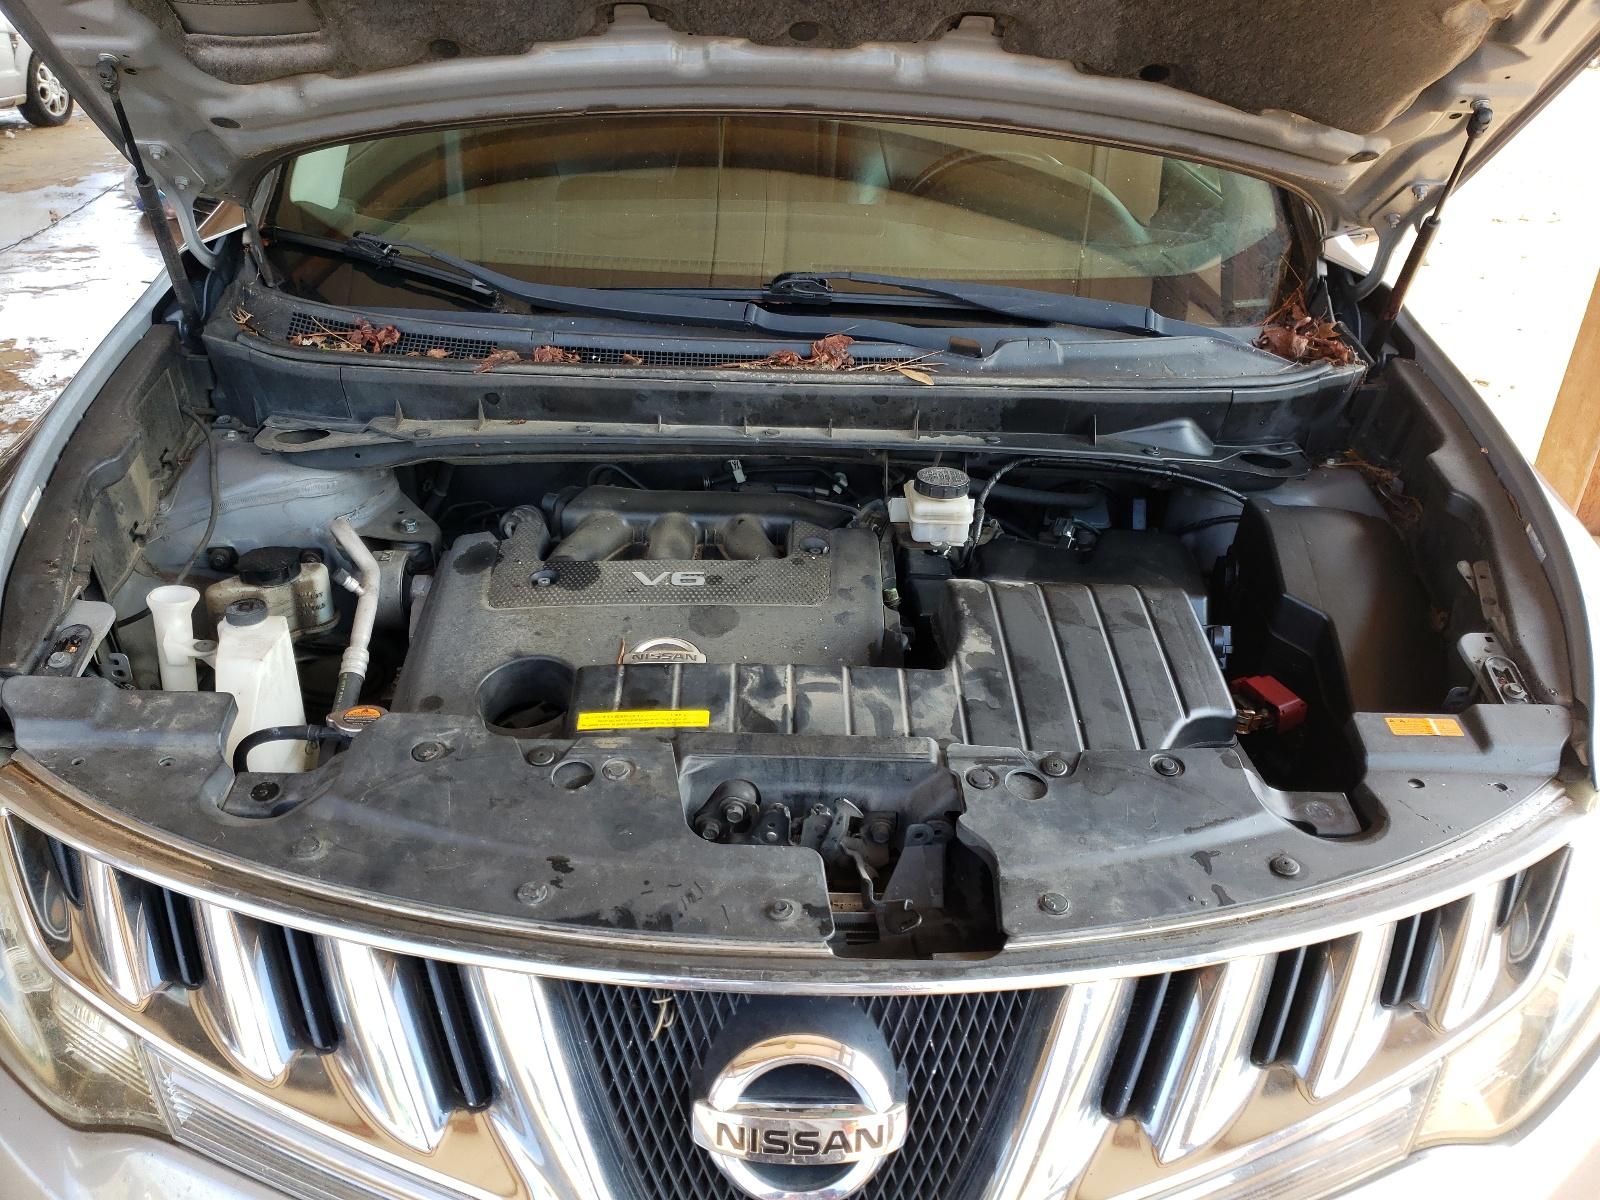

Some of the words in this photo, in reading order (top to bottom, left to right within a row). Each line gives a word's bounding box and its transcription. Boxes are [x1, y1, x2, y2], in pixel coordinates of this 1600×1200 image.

[632, 571, 706, 586] V6
[632, 653, 697, 661] NISSAN
[716, 1122, 884, 1155] NISSAN
